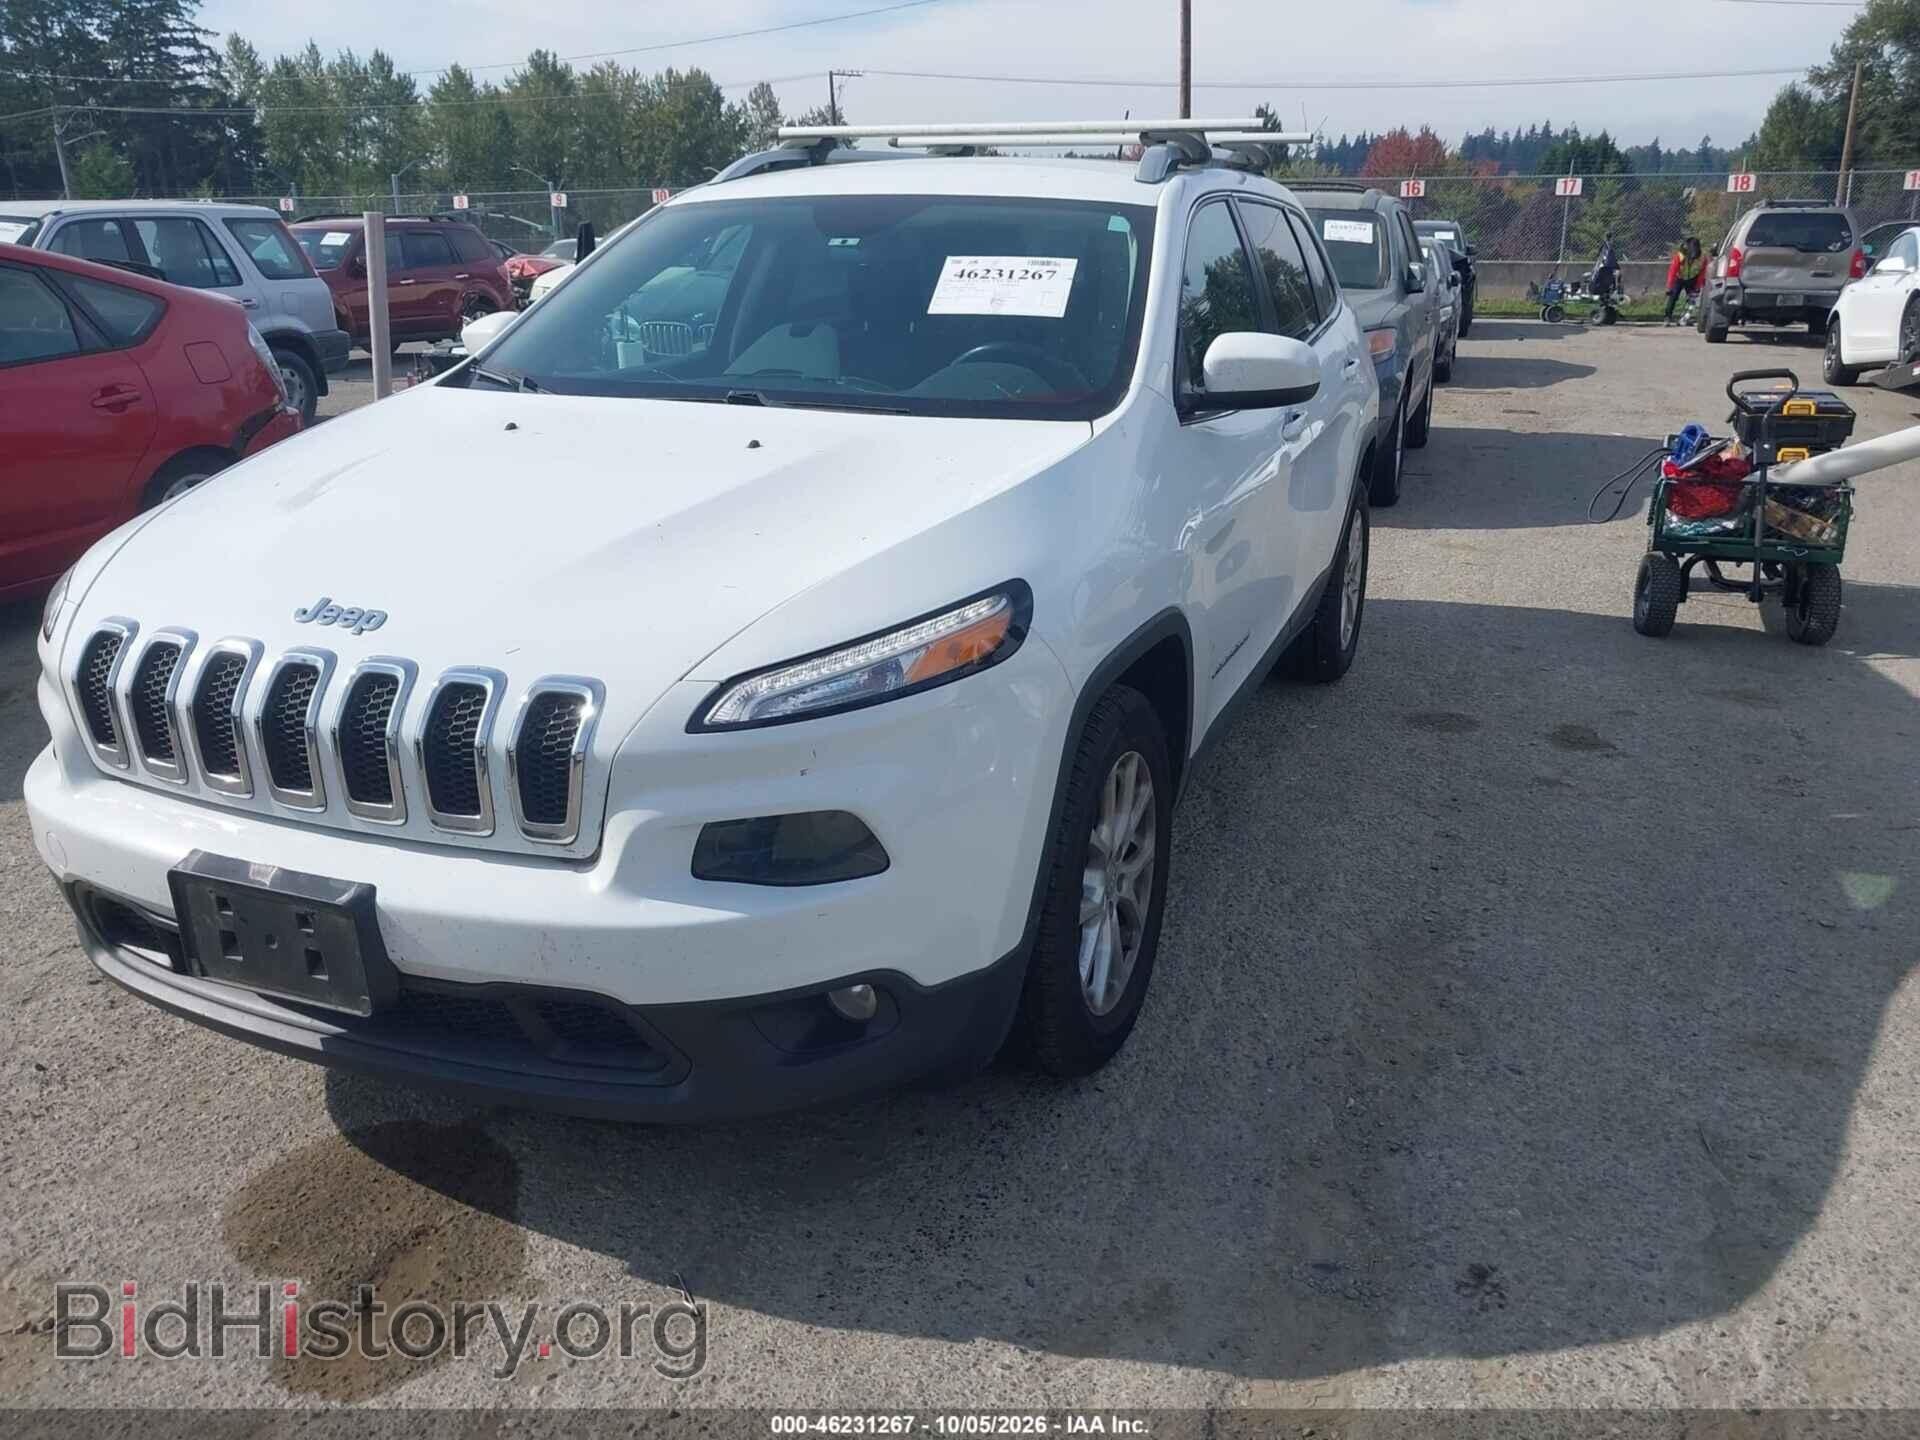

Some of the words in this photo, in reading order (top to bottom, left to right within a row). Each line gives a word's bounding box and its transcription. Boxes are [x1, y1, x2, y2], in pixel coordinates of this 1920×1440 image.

[1562, 179, 1577, 193] 17
[1733, 175, 1750, 191] 18
[1910, 172, 1920, 188] 1
[1406, 182, 1421, 195] 16
[655, 190, 668, 202] 10
[953, 268, 1057, 280] 46231267
[294, 597, 388, 636] Jeep
